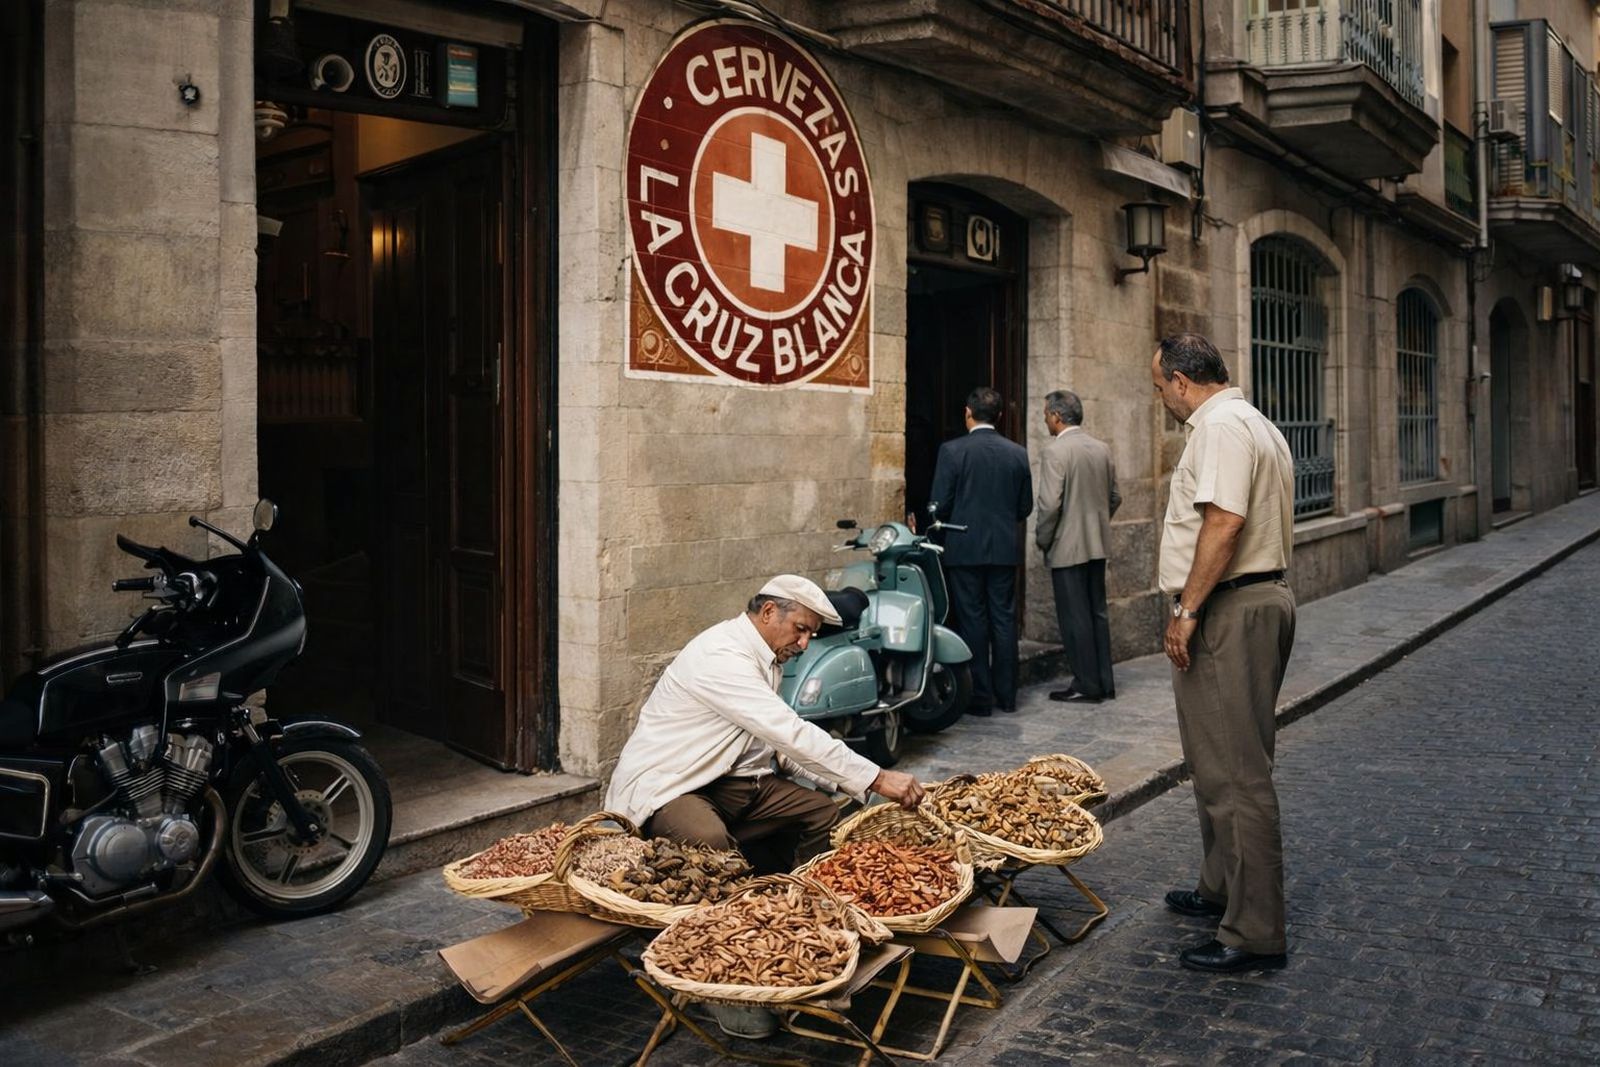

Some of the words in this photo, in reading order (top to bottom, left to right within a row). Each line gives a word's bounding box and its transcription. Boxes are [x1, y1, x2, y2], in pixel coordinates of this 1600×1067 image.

[686, 46, 859, 198] CERVEZAS
[641, 164, 684, 255] LA
[665, 262, 764, 373] CRUZ
[772, 230, 866, 376] BLANCA
